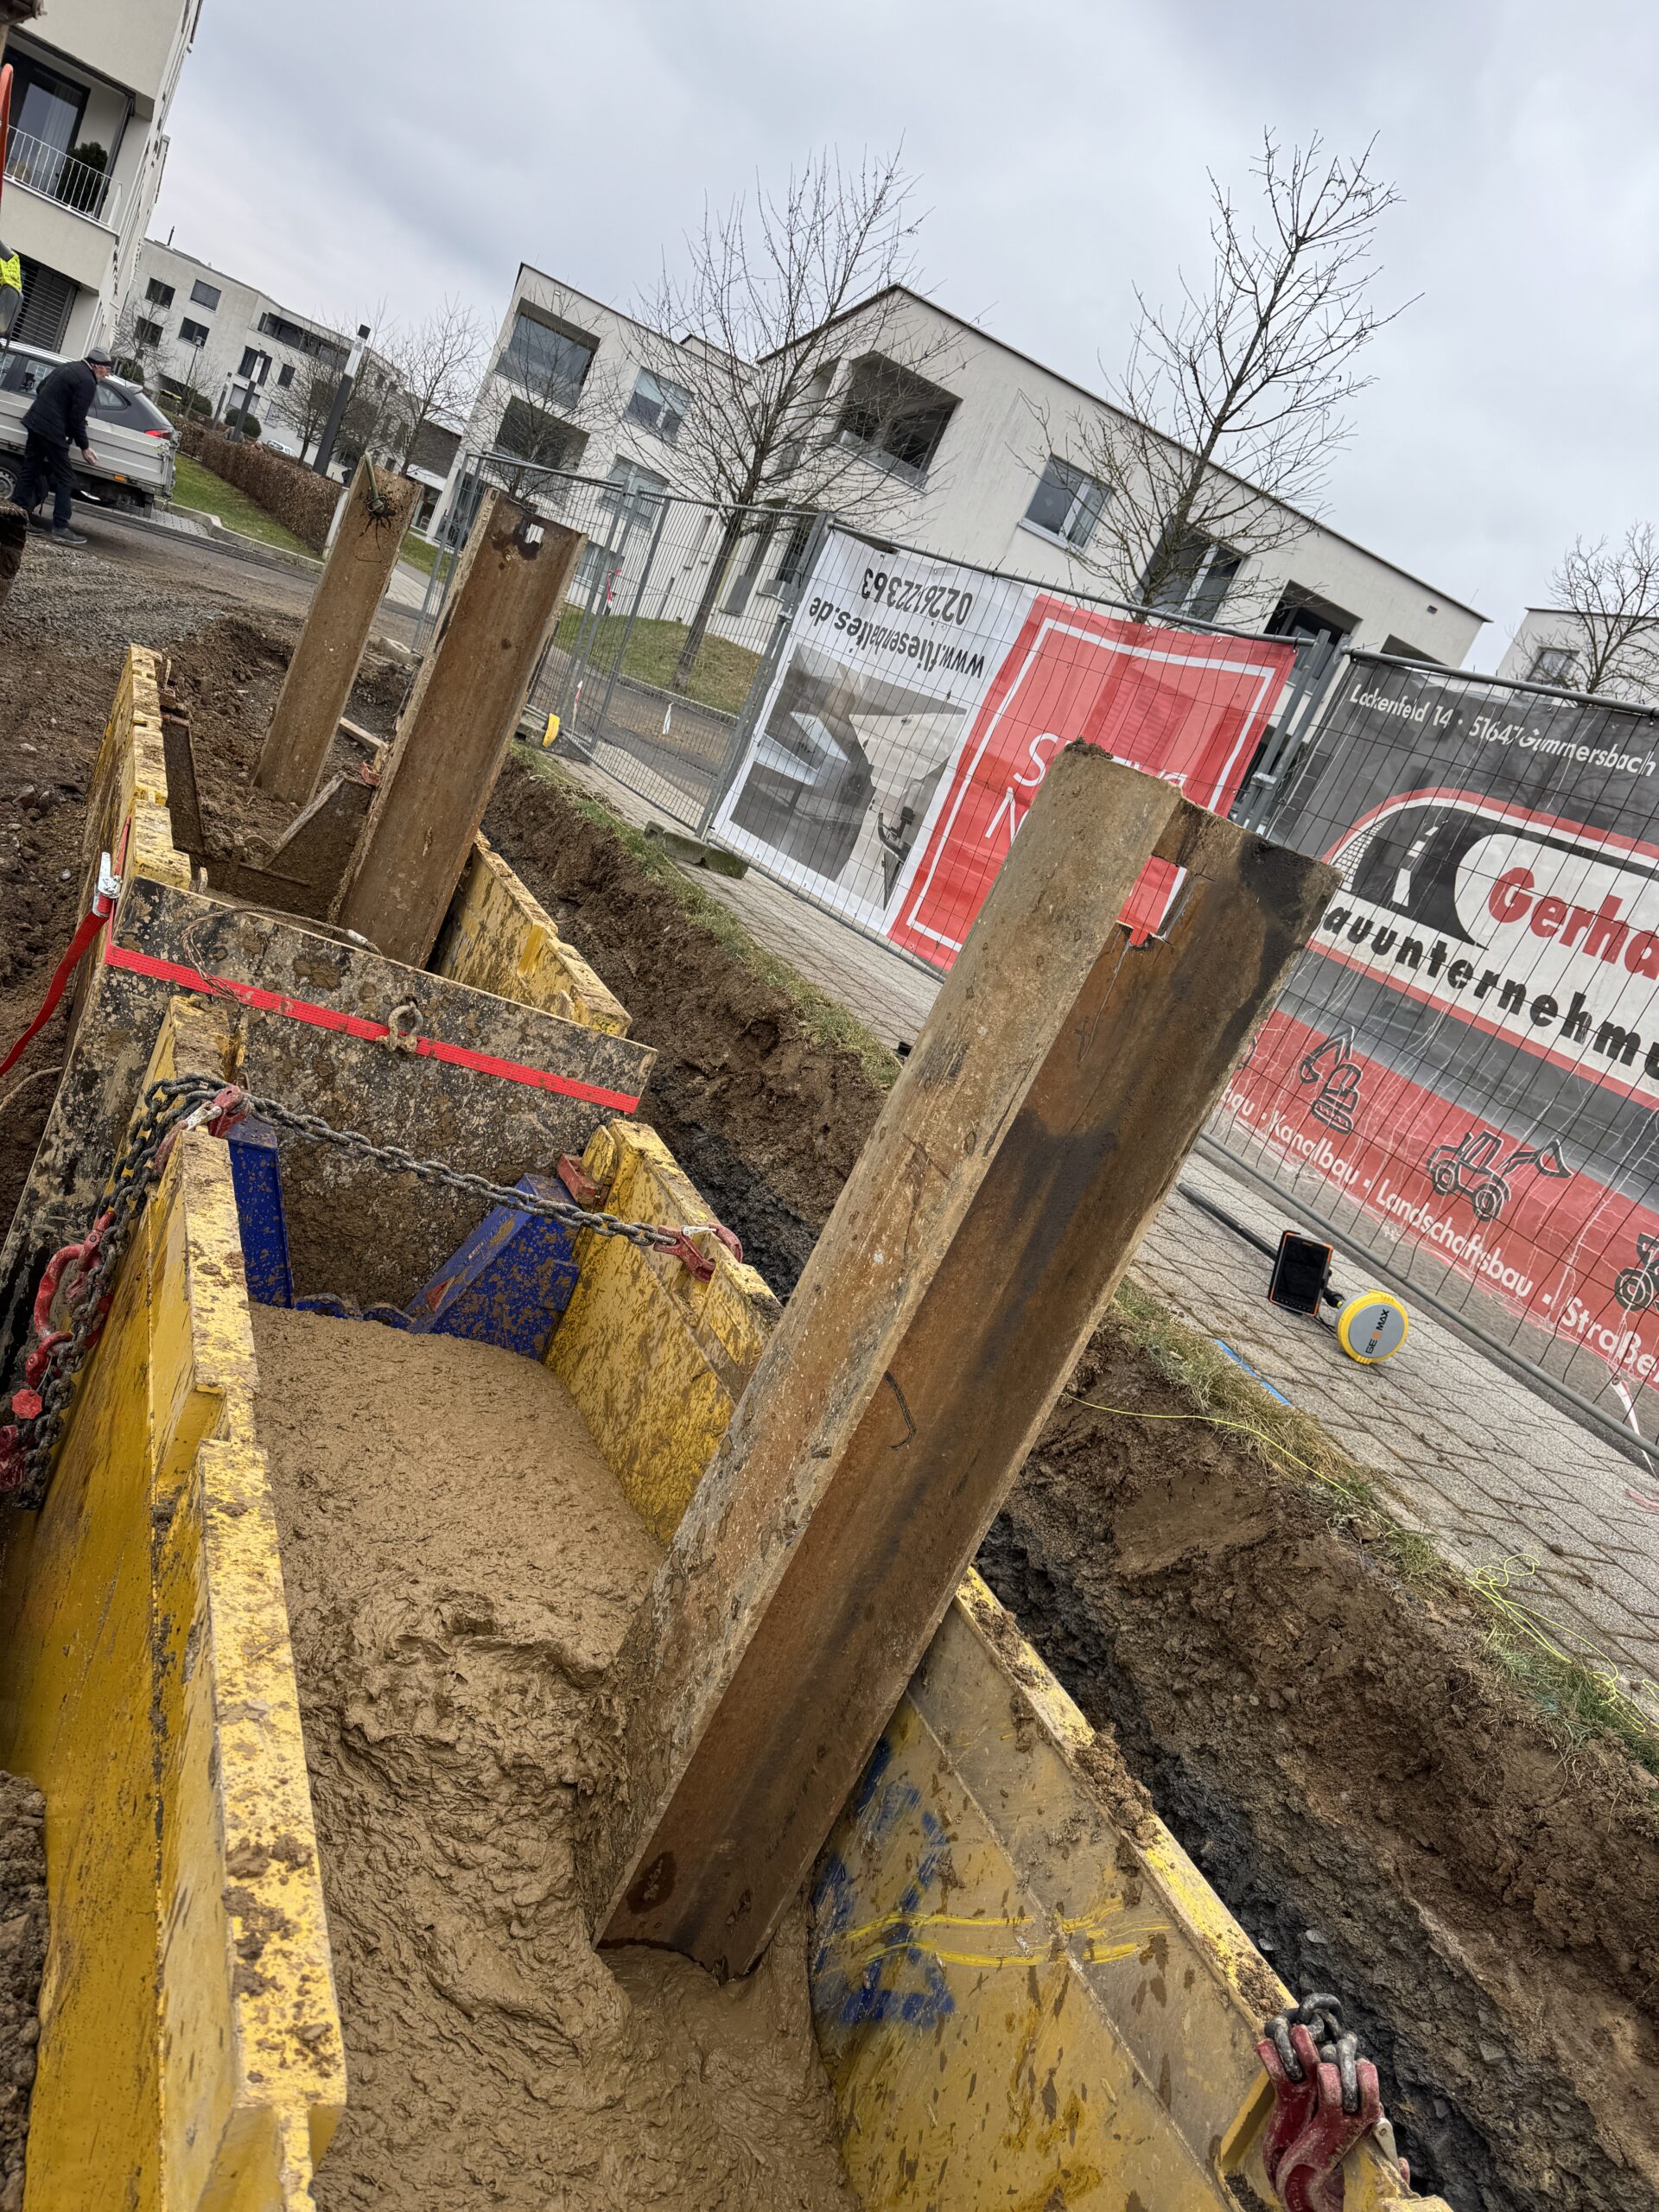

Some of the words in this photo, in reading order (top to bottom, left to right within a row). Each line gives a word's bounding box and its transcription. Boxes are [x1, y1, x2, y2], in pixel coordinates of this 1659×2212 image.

[809, 596, 985, 678] www.fliesenbaltes.de
[1434, 705, 1454, 728] 14
[1470, 715, 1523, 745] 51647
[1518, 728, 1657, 777] Gummersbach
[1268, 1109, 1360, 1188] Kanalbau
[1376, 1178, 1534, 1297] Landschaftsbau
[1562, 1296, 1659, 1383] Straße
